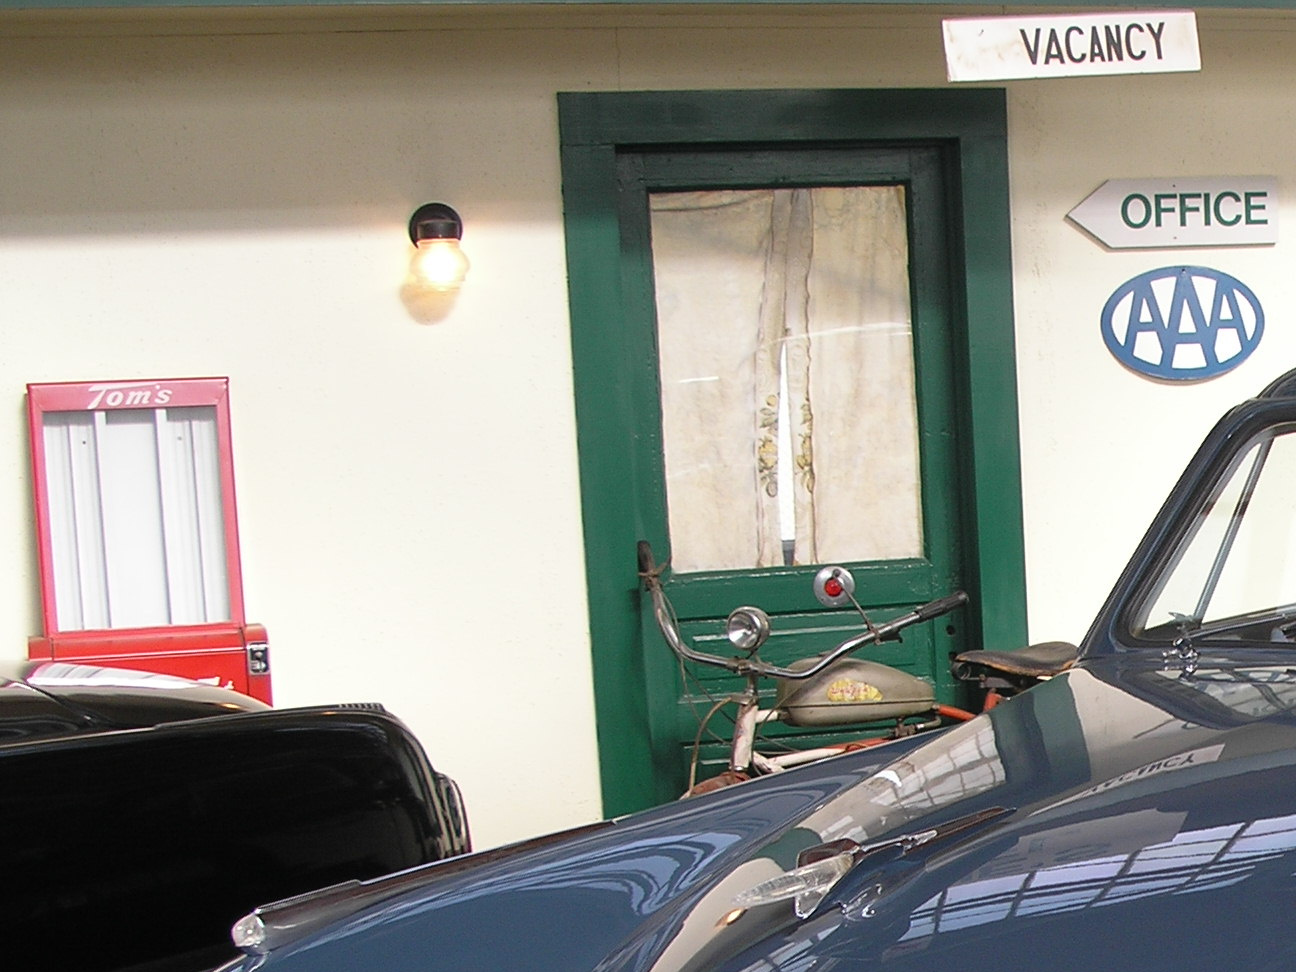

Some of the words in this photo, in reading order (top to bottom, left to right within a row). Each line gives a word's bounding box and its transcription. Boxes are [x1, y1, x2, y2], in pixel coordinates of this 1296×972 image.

[1020, 22, 1165, 65] VACANCY
[1121, 191, 1269, 229] OFFICE
[1104, 269, 1262, 377] AAA
[87, 383, 173, 409] Tom's
